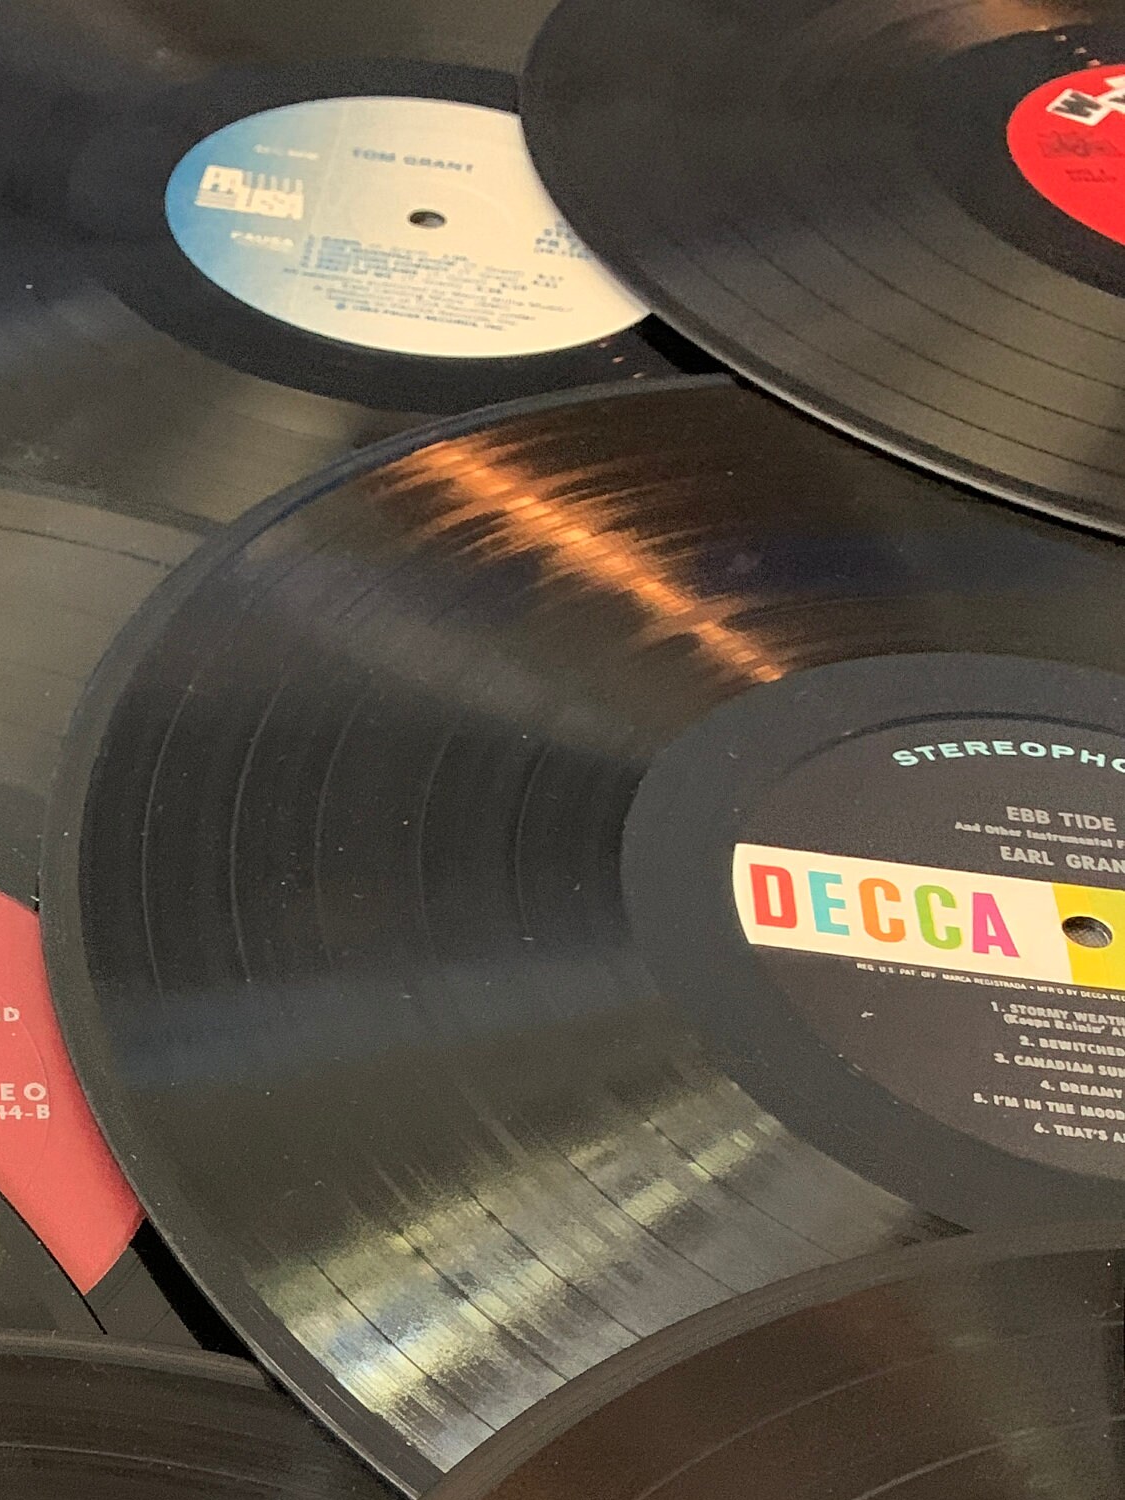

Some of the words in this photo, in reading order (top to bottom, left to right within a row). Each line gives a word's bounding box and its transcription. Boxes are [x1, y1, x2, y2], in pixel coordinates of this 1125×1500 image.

[955, 821, 981, 833] And
[1006, 806, 1051, 825] EBB
[1058, 812, 1117, 832] TIDE
[1000, 846, 1055, 866] EARL
[749, 863, 1021, 959] DECCA
[1080, 990, 1108, 1000] DECCA
[1009, 1003, 1069, 1020] STORMY
[1038, 1037, 1125, 1057] BEWITCHED
[1014, 1055, 1094, 1074] CANADIAN
[1059, 1081, 1122, 1099] DREAMY
[993, 1095, 1019, 1108] I'M
[1024, 1098, 1042, 1111] IN
[1045, 1101, 1075, 1115] THE
[1053, 1124, 1108, 1141] THAT'S
